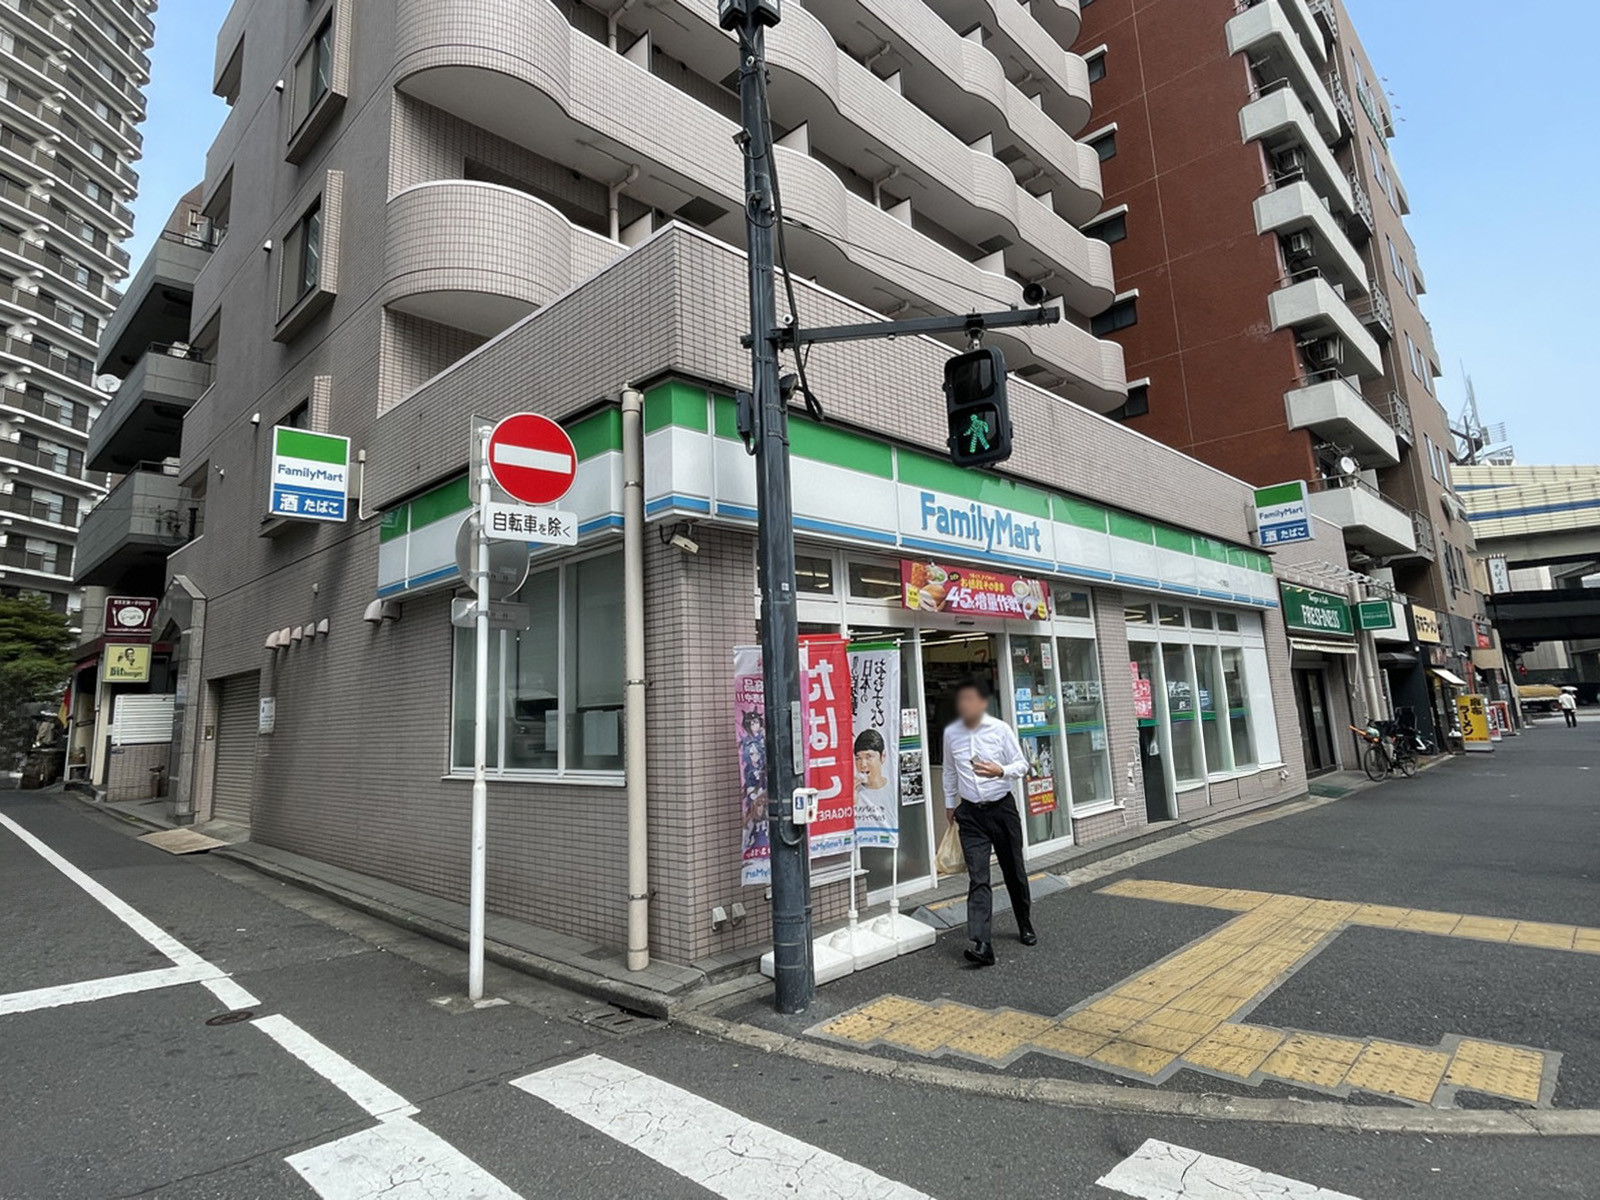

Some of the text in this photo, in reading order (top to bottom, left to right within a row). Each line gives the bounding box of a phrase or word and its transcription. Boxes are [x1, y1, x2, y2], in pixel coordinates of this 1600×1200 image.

[278, 464, 343, 482] FamilyMart
[279, 493, 340, 515] 酒 たばこ
[1259, 506, 1304, 520] FamilyMart
[493, 511, 571, 538] 自転車を除く
[920, 491, 1041, 553] FamilyMart
[1265, 526, 1307, 543] 酒 たばこ
[1301, 604, 1341, 629] FRESHNESS
[1459, 705, 1474, 736] ラーメン
